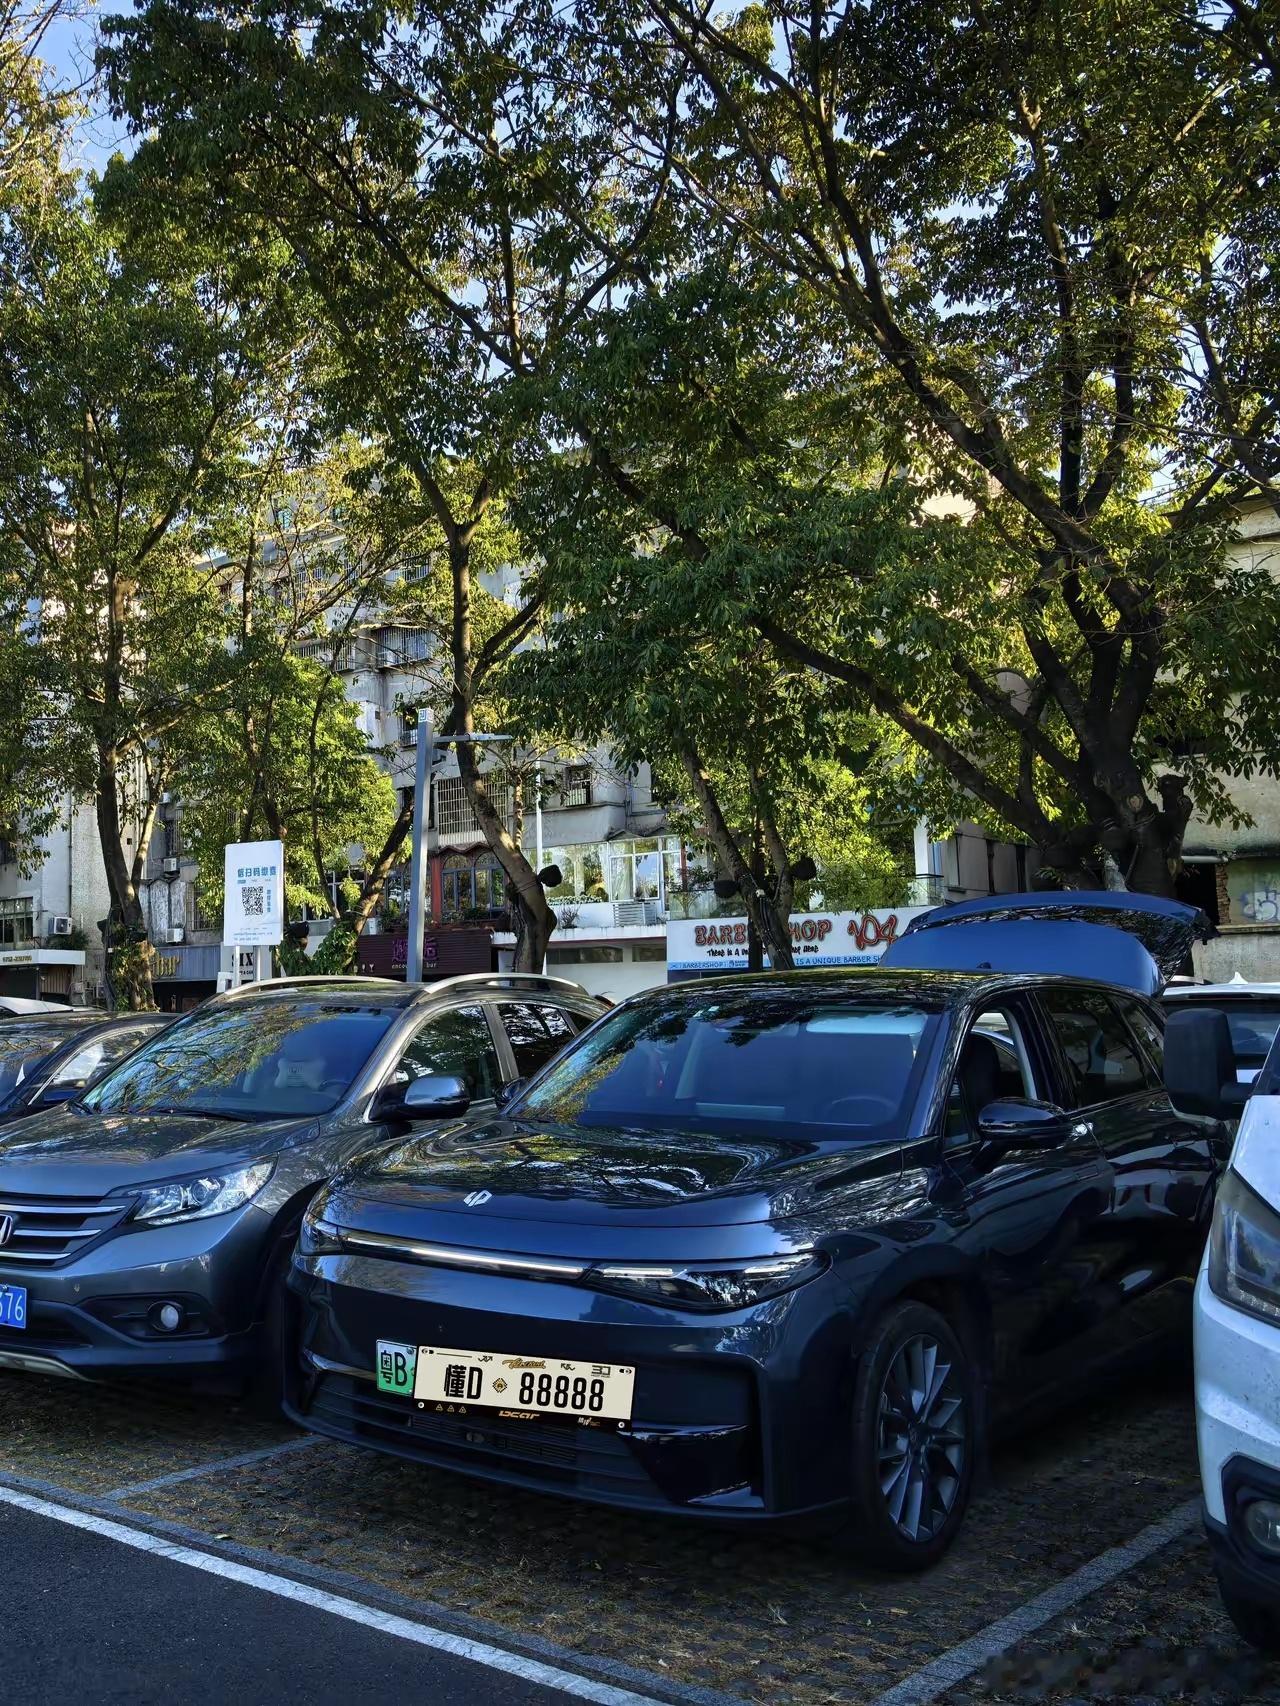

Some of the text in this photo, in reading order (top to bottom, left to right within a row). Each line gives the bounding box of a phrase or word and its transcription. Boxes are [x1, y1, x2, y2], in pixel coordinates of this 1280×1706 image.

[812, 956, 842, 965] UNIQUE
[843, 955, 872, 963] BARBER
[518, 1371, 605, 1412] 88888
